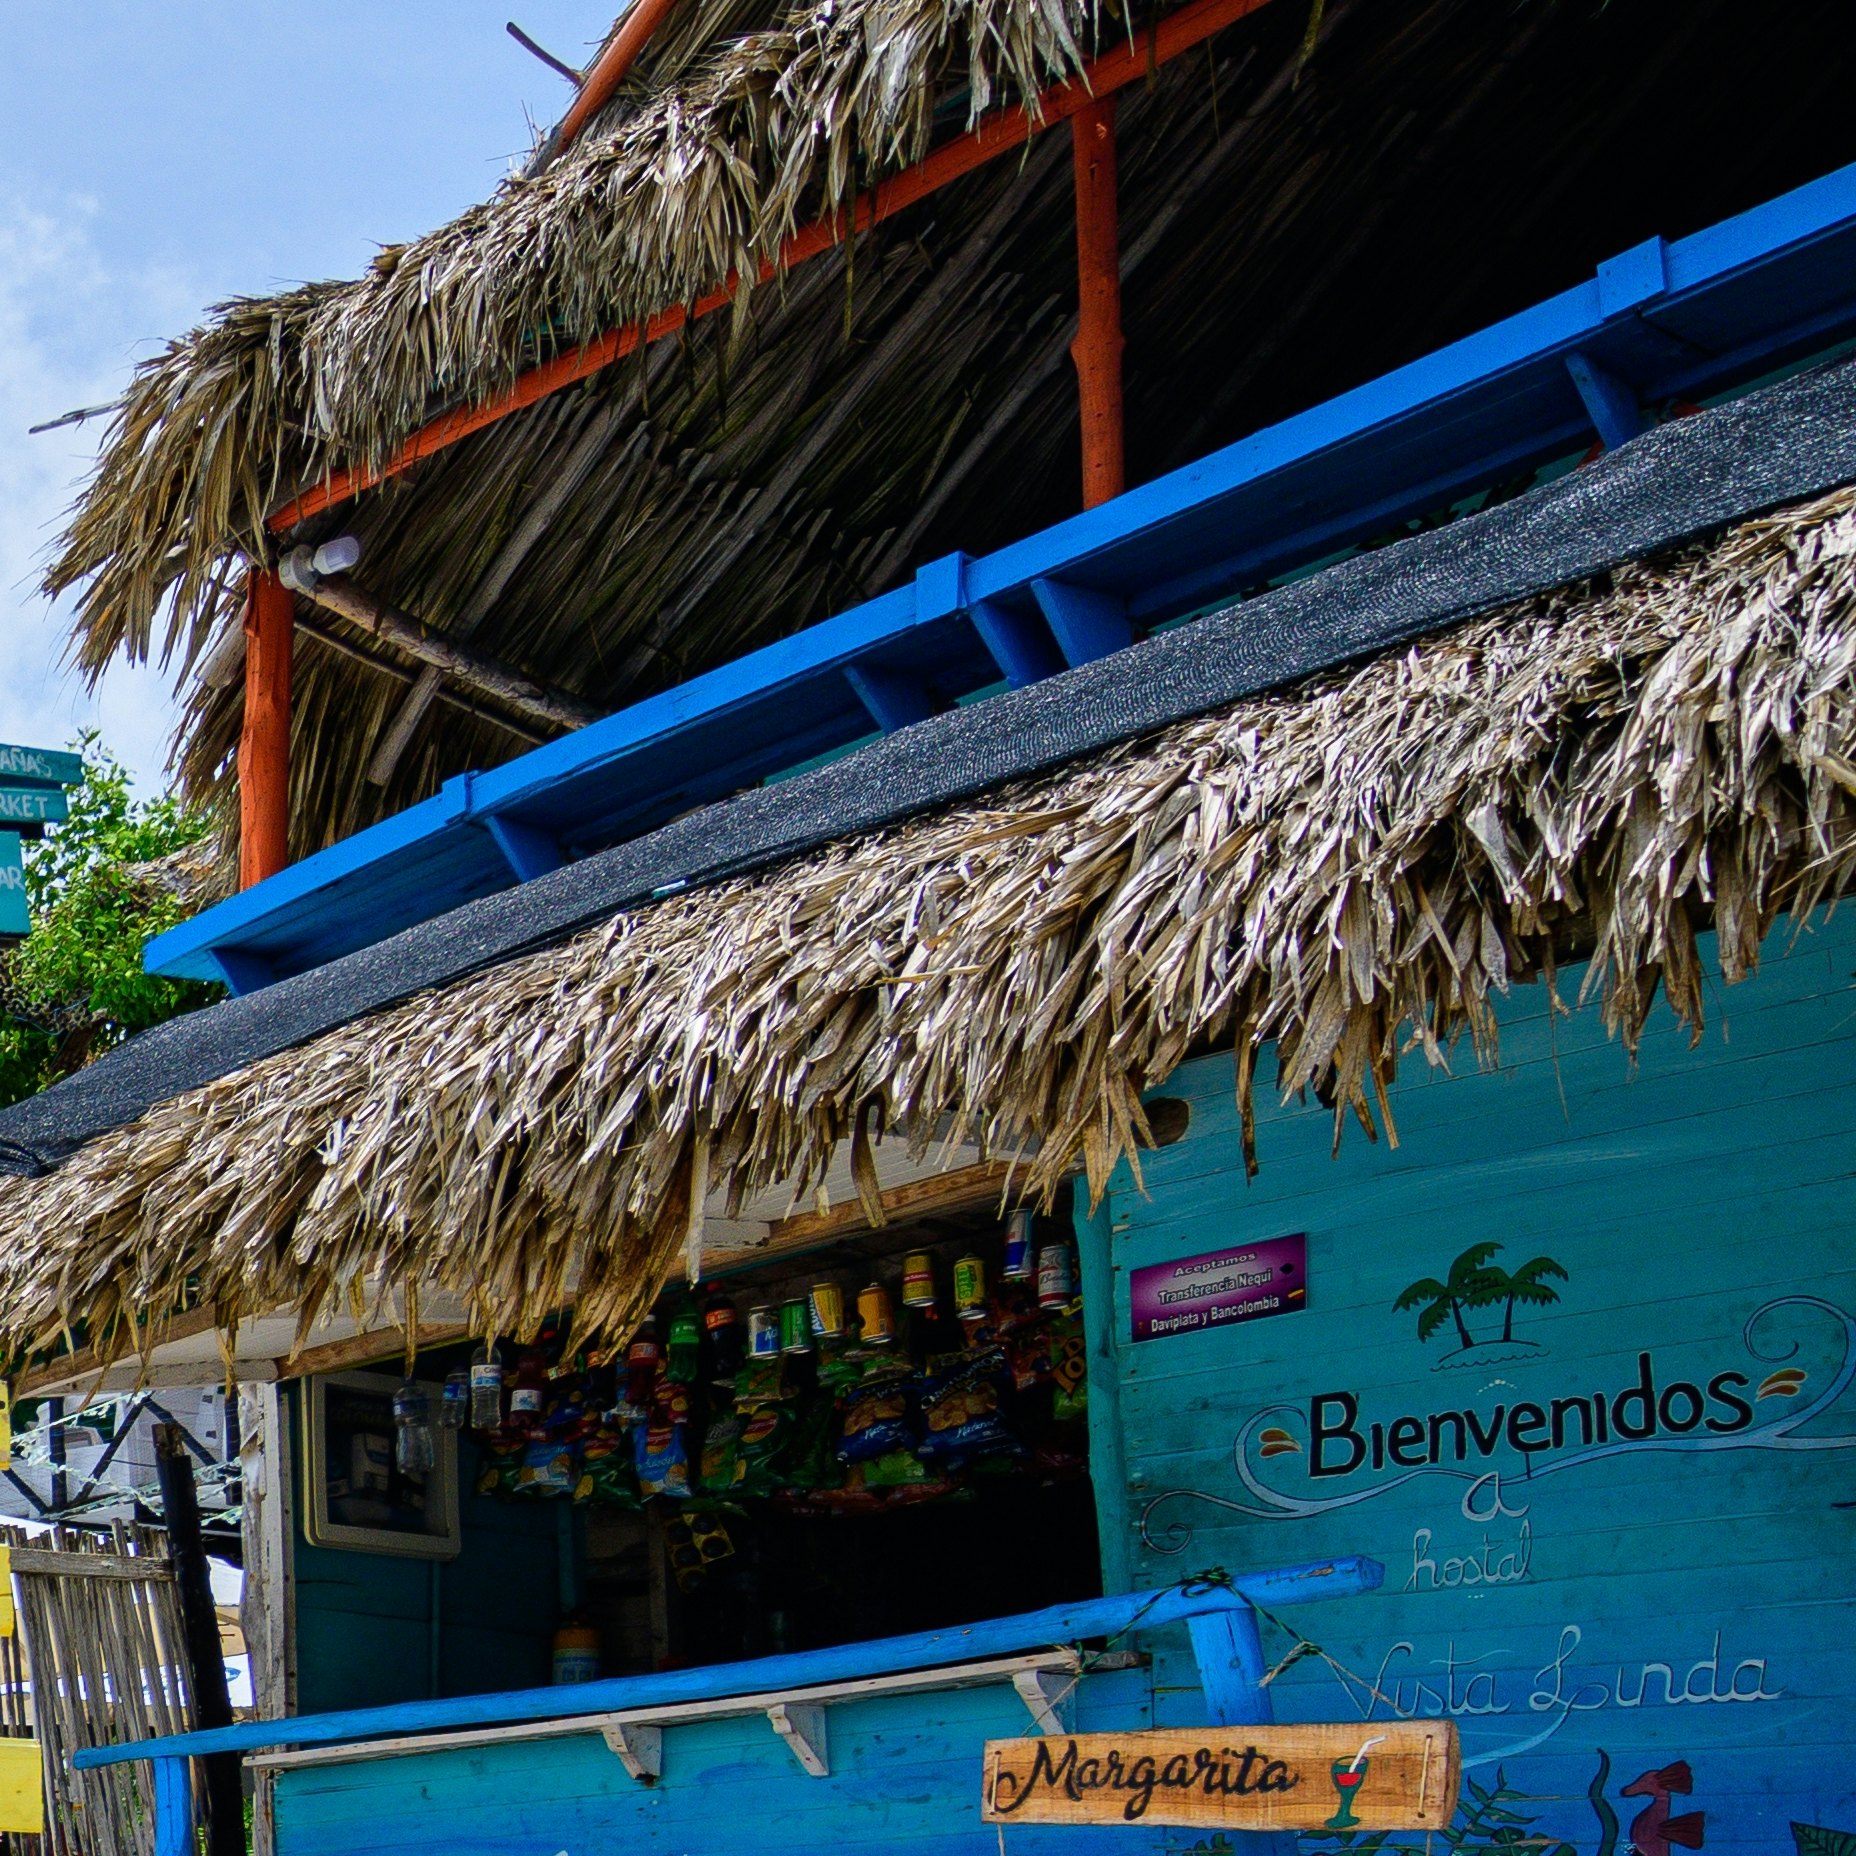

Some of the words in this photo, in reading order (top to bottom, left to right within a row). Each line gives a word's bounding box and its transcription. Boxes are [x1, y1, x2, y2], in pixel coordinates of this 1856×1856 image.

[1159, 1277, 1237, 1306] Transferencia
[1237, 1269, 1273, 1288] Nequi
[1173, 1252, 1257, 1278] Aceptamos
[1150, 1312, 1200, 1333] Daviplata
[1201, 1312, 1209, 1326] y
[1210, 1294, 1281, 1321] Bancolombia
[1308, 1352, 1754, 1479] Bienvenidos
[1460, 1470, 1530, 1523] a
[1402, 1518, 1536, 1592] hostal
[1316, 1640, 1514, 1721] Vista
[1526, 1624, 1790, 1714] Linda
[989, 1740, 1301, 1821] Margarita
